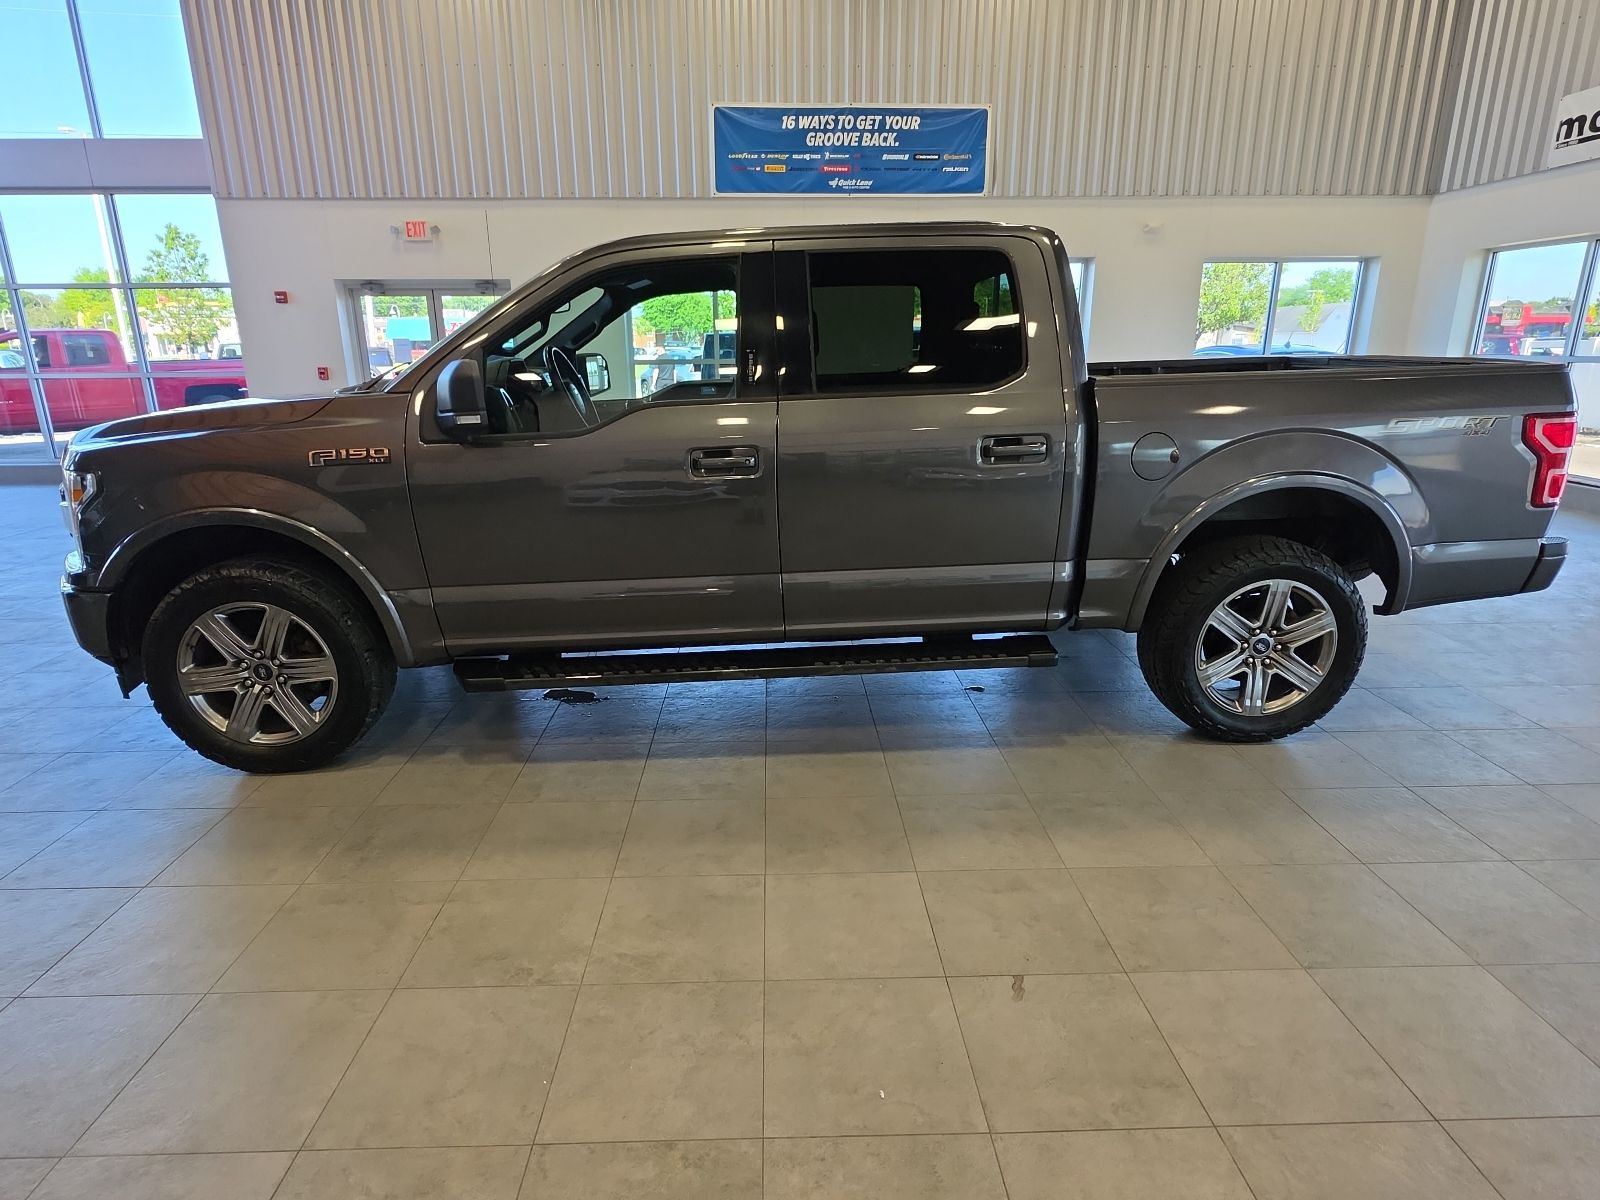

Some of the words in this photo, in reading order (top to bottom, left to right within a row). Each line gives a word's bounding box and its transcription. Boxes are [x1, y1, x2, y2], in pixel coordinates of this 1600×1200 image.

[781, 115, 796, 129] 16
[798, 115, 835, 129] WAYS
[837, 115, 854, 129] TO
[856, 115, 882, 129] GET
[885, 116, 921, 130] YOUR
[805, 132, 860, 146] GROOVE
[861, 132, 900, 147] BACK.
[405, 221, 426, 237] EXIT
